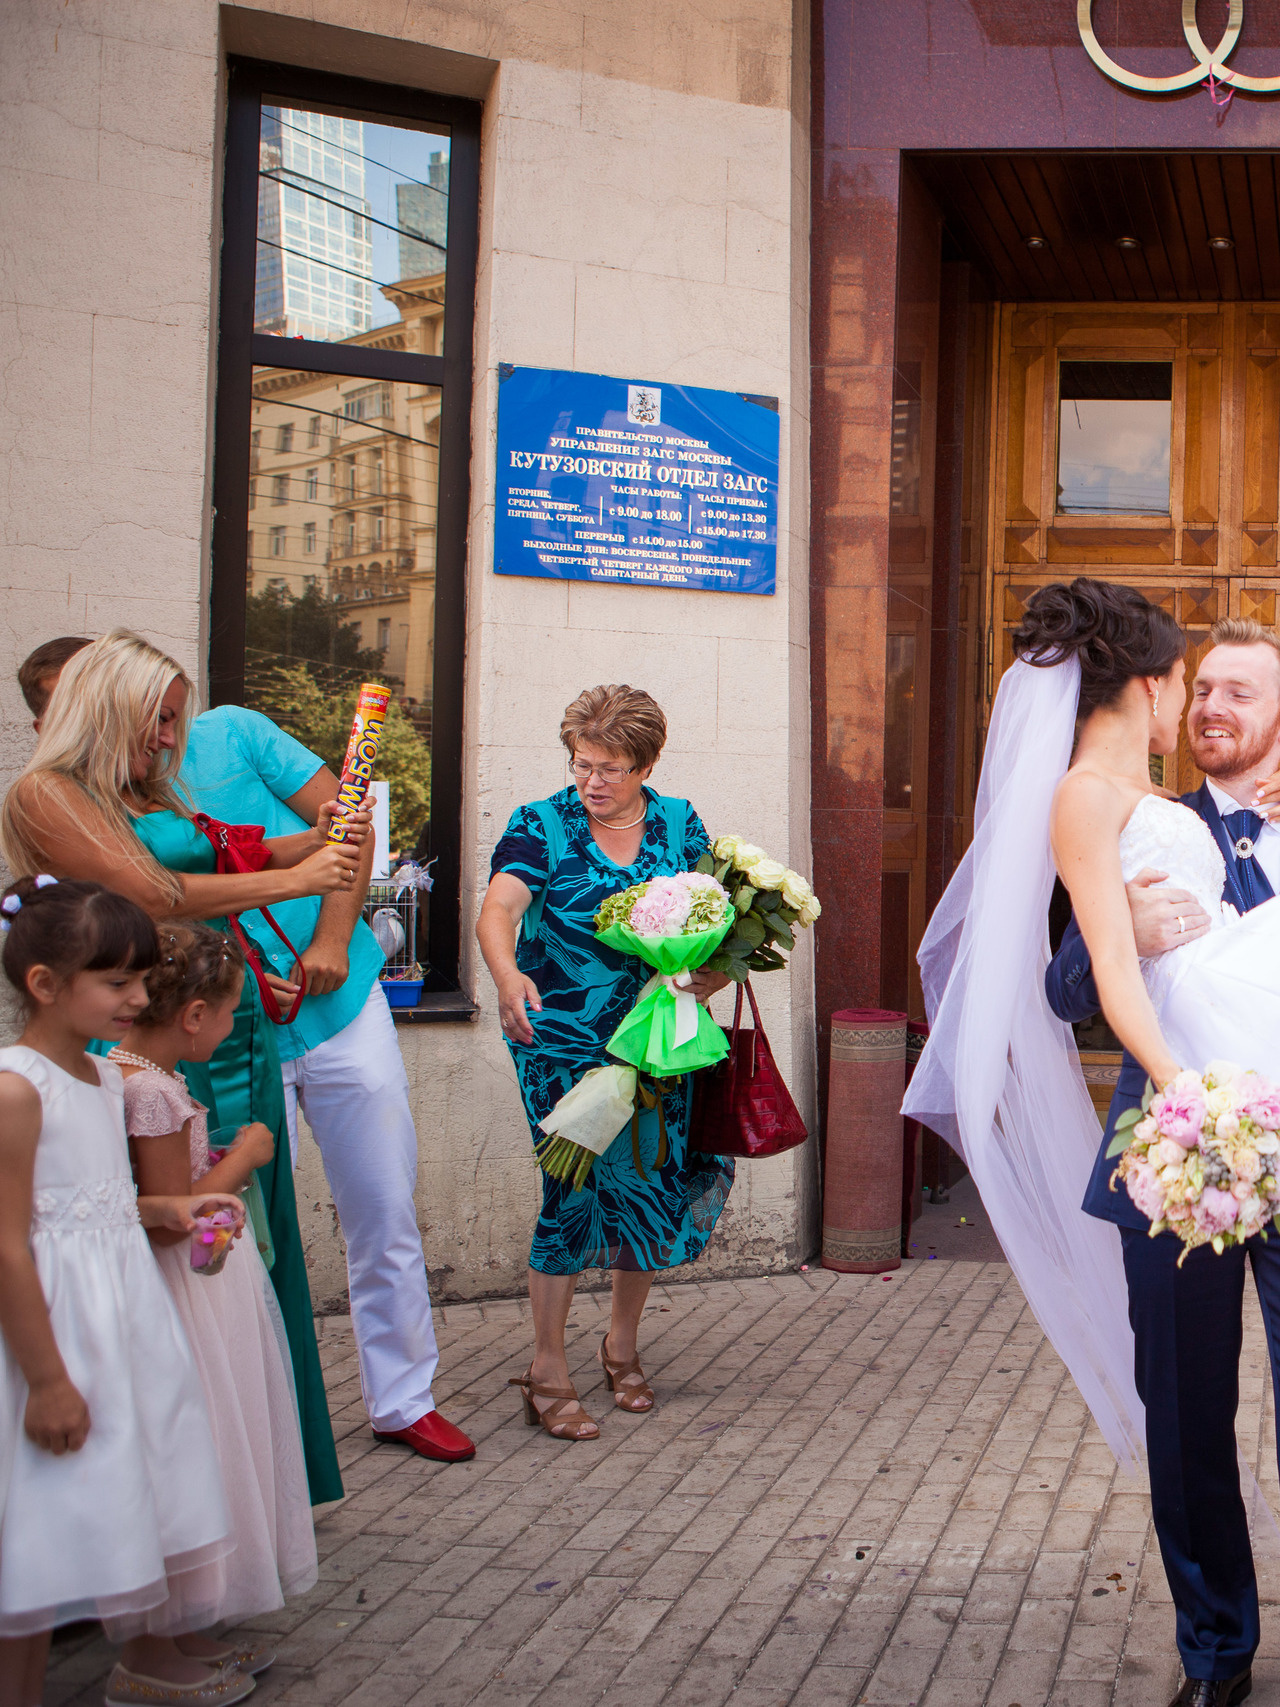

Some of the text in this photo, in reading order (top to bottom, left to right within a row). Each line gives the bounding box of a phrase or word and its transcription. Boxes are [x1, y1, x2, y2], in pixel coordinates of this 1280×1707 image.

[576, 426, 709, 449] ПРАВИТЕЛЬСТВО МОСКВЫ
[550, 437, 732, 466] УПРАВЛЕНИЕ ЗАГС МОСКВЫ
[510, 450, 768, 493] КУТУЗОВСКИЙ ОТДЕЛ ЗАГС
[508, 487, 552, 498] ВТОРНИК,
[610, 485, 682, 500] ЧАСЫ РАБОТЫ:
[508, 498, 582, 512] СРЕДА, ЧЕТВЕРГ,
[697, 494, 768, 508] ЧАСЫ ПРИЕМА:
[508, 509, 595, 524] ПЯТНИЦА, СУББОТА
[609, 506, 682, 522] с 9.00 до 18.00
[708, 510, 728, 520] 9.00
[728, 514, 740, 522] до
[742, 513, 767, 524] 13.30
[574, 530, 626, 542] ПЕРЕРЫВ
[638, 536, 664, 546] 14.00
[665, 540, 676, 548] до
[678, 539, 703, 550] 15.00
[702, 526, 727, 536] 15.00
[742, 530, 767, 540] 17.30
[523, 540, 752, 566] ВЫХОДНЫЕ ДНИ: ВОСКРЕСЕНЬЕ, ПОНЕДЕЛЬНИК
[539, 554, 598, 566] ЧЕТВЕРТЫЙ
[601, 560, 643, 570] ЧЕТВЕРГ
[645, 562, 692, 574] КАЖДОГО
[591, 568, 688, 582] САНИТАРНЫЙ ДЕНЬ
